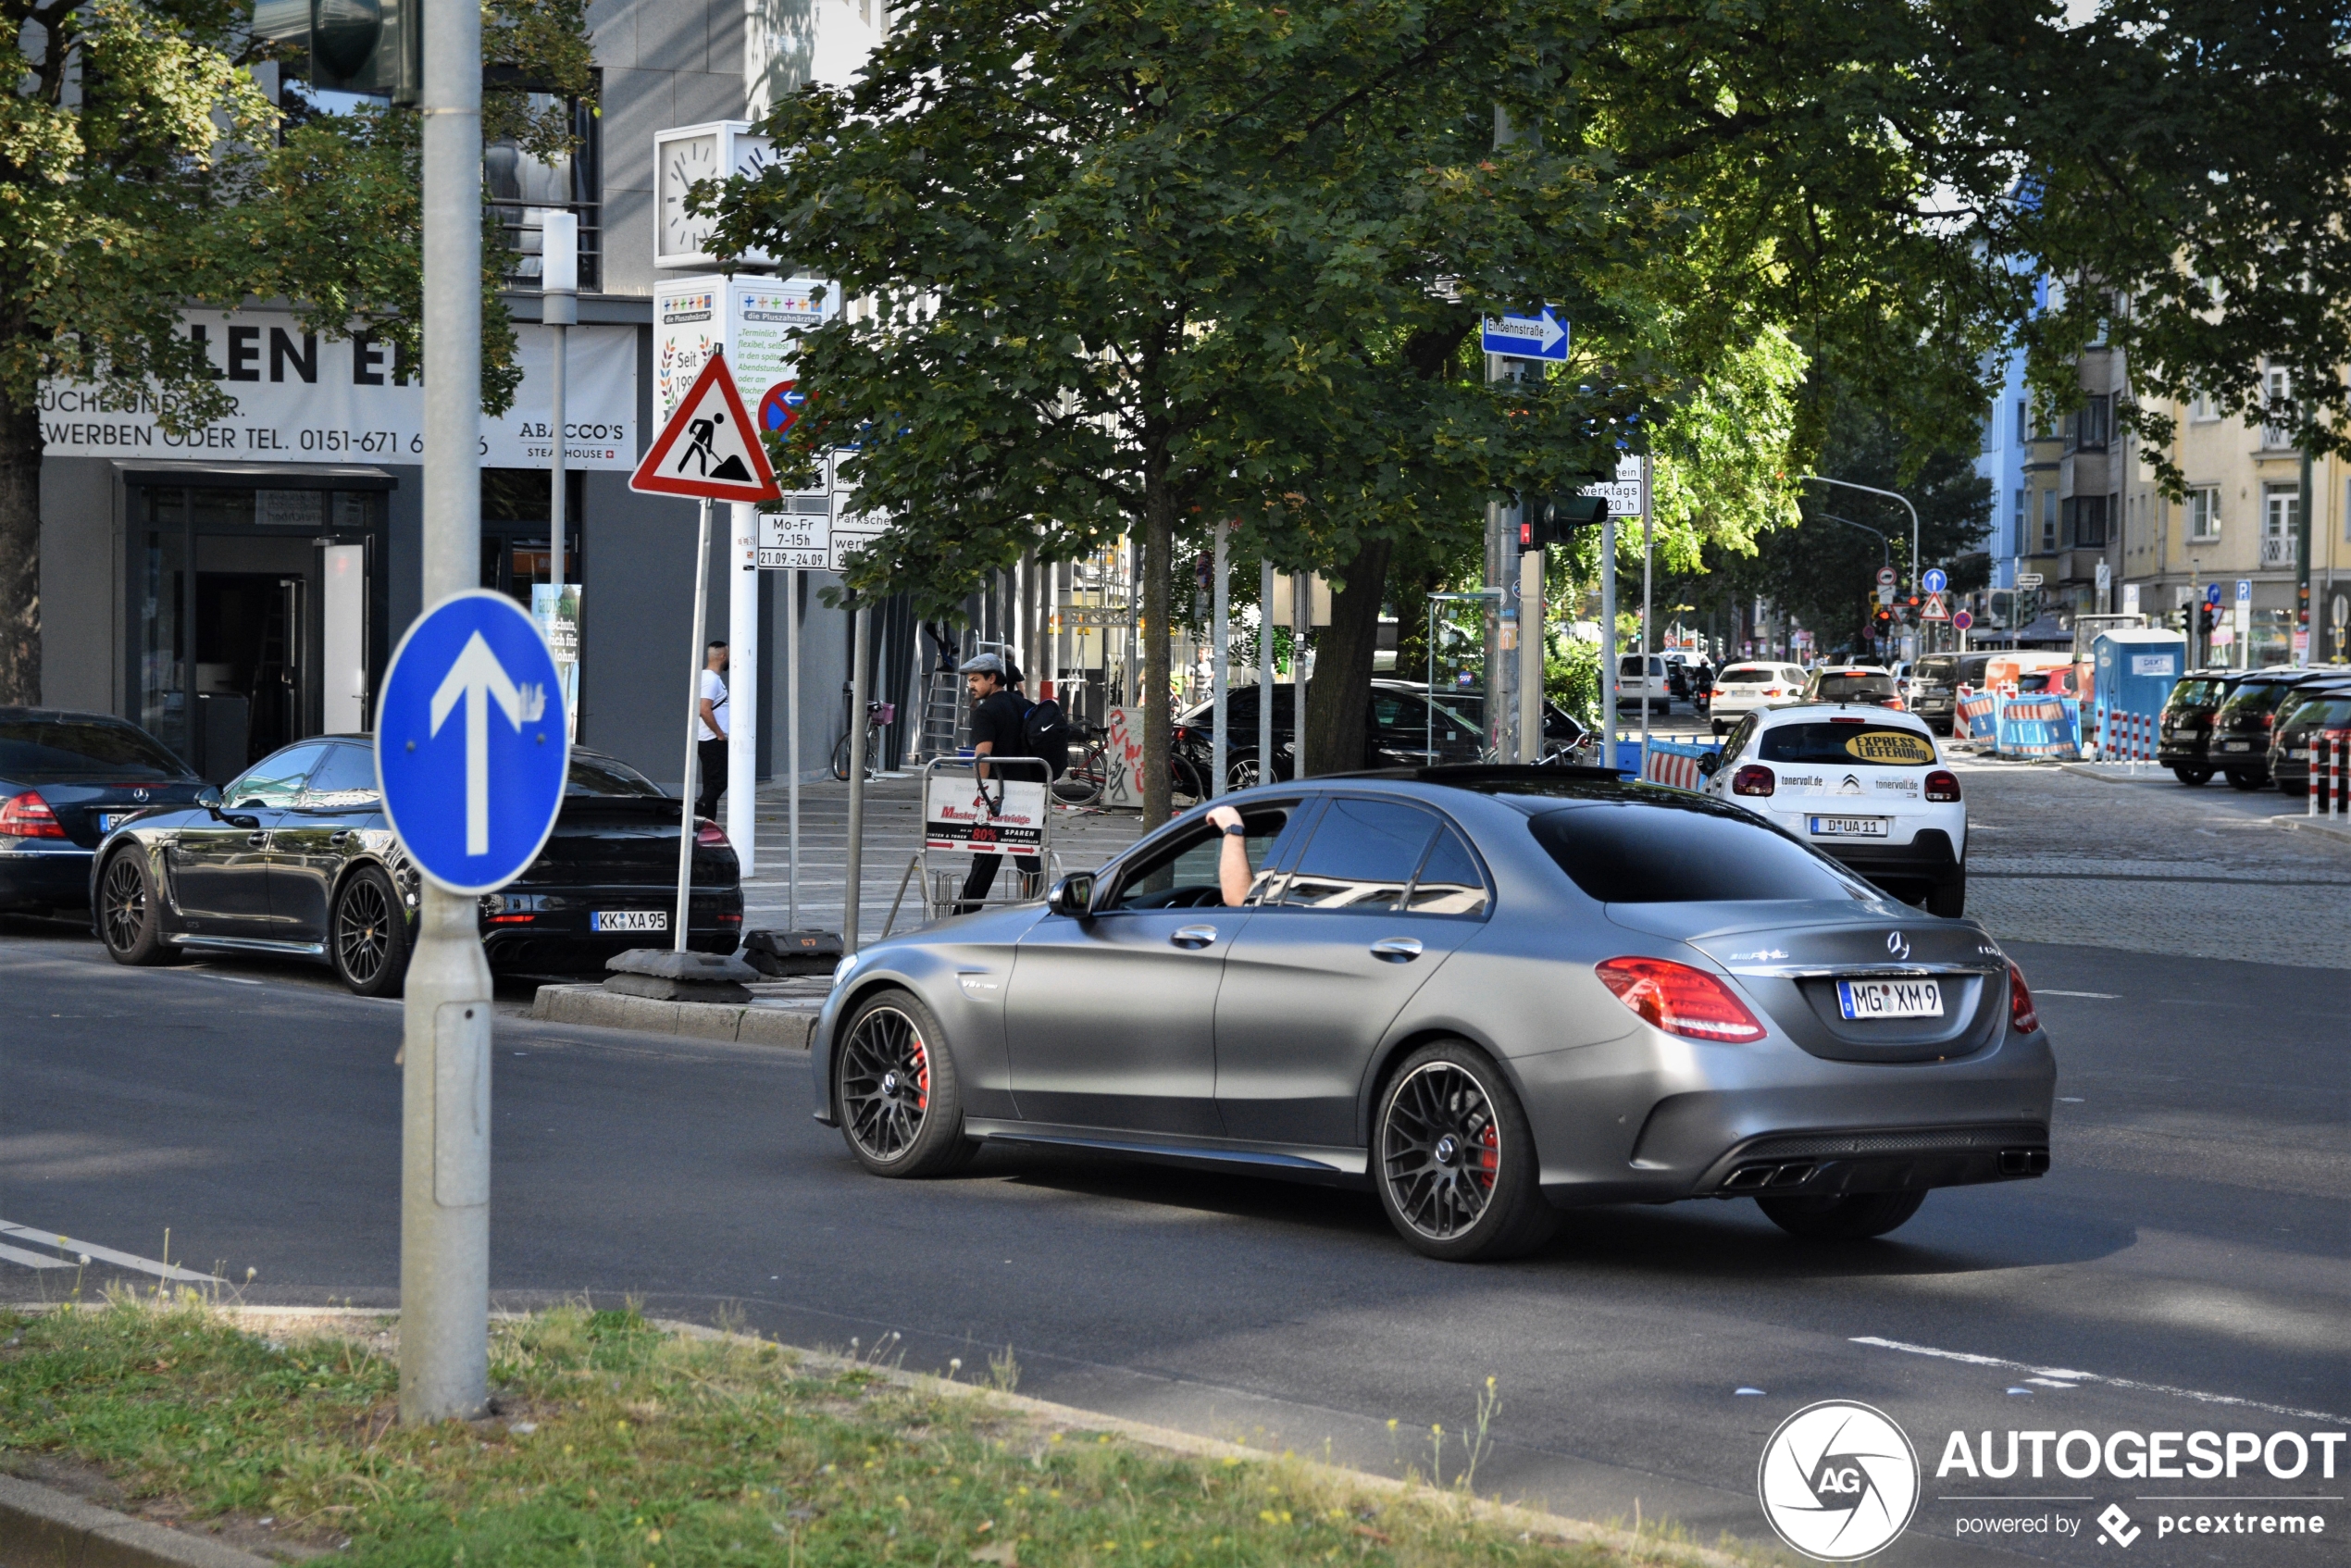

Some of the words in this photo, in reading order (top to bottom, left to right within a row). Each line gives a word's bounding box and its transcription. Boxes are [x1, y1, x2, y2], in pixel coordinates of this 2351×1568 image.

[1487, 318, 1545, 338] Einbahnstraße
[738, 340, 766, 350] flexibel,
[767, 341, 789, 350] selbst
[678, 351, 697, 368] Seit
[761, 354, 784, 362] späte
[738, 363, 788, 372] Abendstunden
[39, 385, 112, 413] ÜCHE
[163, 426, 236, 449] ODER
[245, 429, 290, 450] TEL.
[300, 429, 398, 453] 0151-671
[529, 448, 603, 459] STEAHOUSE
[1583, 485, 1637, 499] werktags
[1627, 500, 1635, 511] h
[773, 518, 814, 530] Mo-Fr
[777, 534, 811, 546] 7-15h
[760, 552, 826, 566] 21.09.-24.09.
[566, 633, 578, 647] für
[1854, 736, 1917, 749] EXPRESS
[1858, 746, 1928, 762] LIEFERUNG
[1782, 776, 1822, 787] tonervoll.de
[1875, 780, 1919, 790] tonervoll.de
[940, 805, 977, 821] Master
[1827, 819, 1836, 831] D
[1844, 820, 1860, 832] UA
[1862, 821, 1878, 833] 11
[972, 828, 997, 841] 80%
[600, 913, 619, 929] KK
[628, 913, 646, 928] XA
[649, 913, 665, 928] 95
[1853, 985, 1883, 1013] MG
[1894, 984, 1923, 1012] XM
[1925, 984, 1937, 1011] 9
